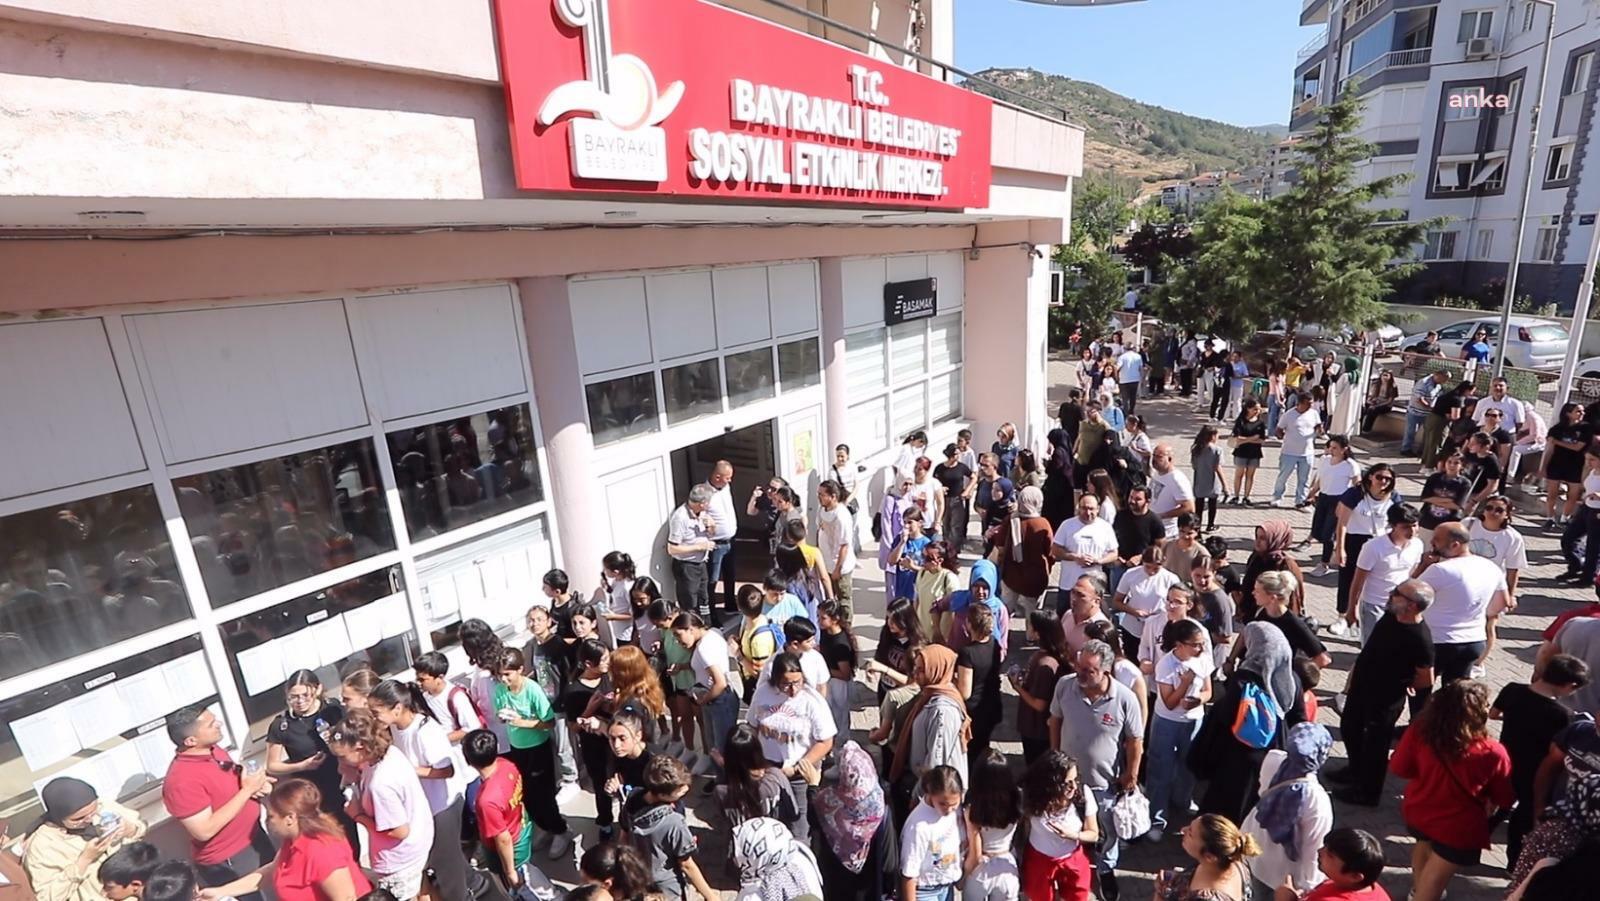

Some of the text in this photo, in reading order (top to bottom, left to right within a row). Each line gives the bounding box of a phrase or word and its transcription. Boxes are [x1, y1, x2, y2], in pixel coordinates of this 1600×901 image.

[847, 64, 890, 107] T.C.
[730, 78, 962, 157] BAYRAKLI BELEDİYES
[584, 133, 659, 157] BAYRAKLI
[688, 127, 791, 185] SOSYAL
[902, 297, 934, 313] BASAMAK
